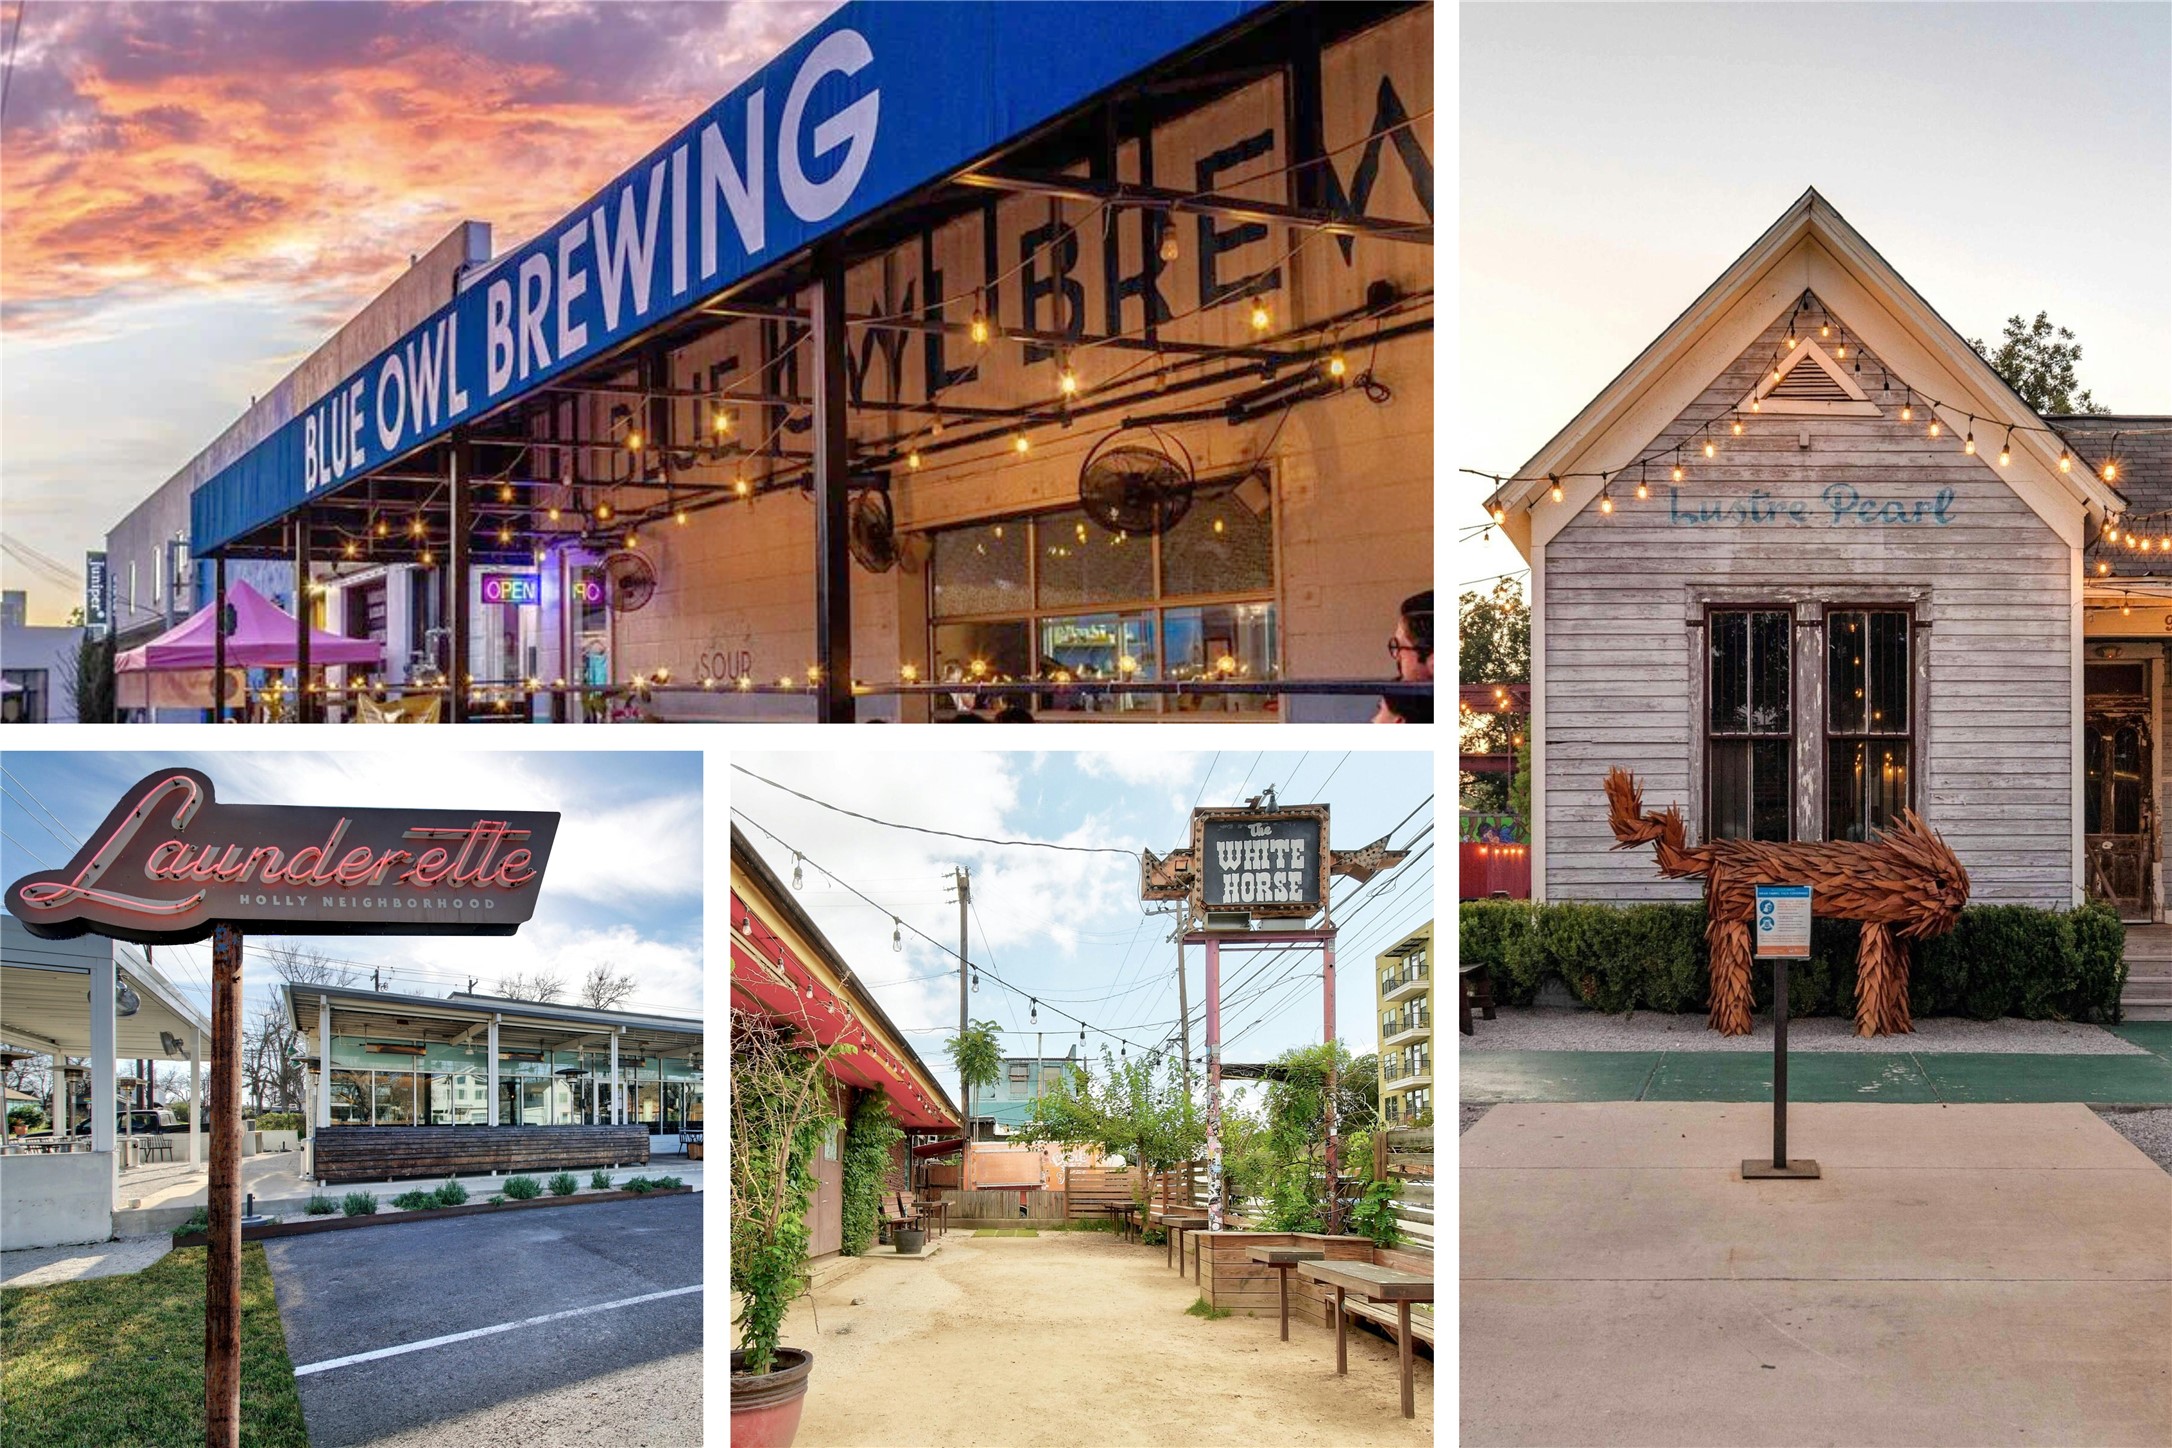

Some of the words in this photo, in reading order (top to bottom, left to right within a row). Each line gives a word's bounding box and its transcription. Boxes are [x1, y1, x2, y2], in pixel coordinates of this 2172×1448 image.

[305, 378, 365, 492] BLUE
[376, 312, 468, 450] OWL
[487, 28, 880, 397] BREWING
[1669, 486, 1813, 526] Lustre
[1821, 483, 1957, 526] Pearl
[88, 558, 105, 611] Juniper
[486, 580, 536, 599] OPEN
[700, 651, 752, 680] SOUR
[19, 775, 537, 914] Launderette
[1247, 822, 1272, 837] The
[1216, 839, 1304, 871] WHITE
[240, 894, 307, 907] HOLLY
[322, 895, 496, 910] NEIGHBORHOOD
[1222, 871, 1303, 903] HORSE
